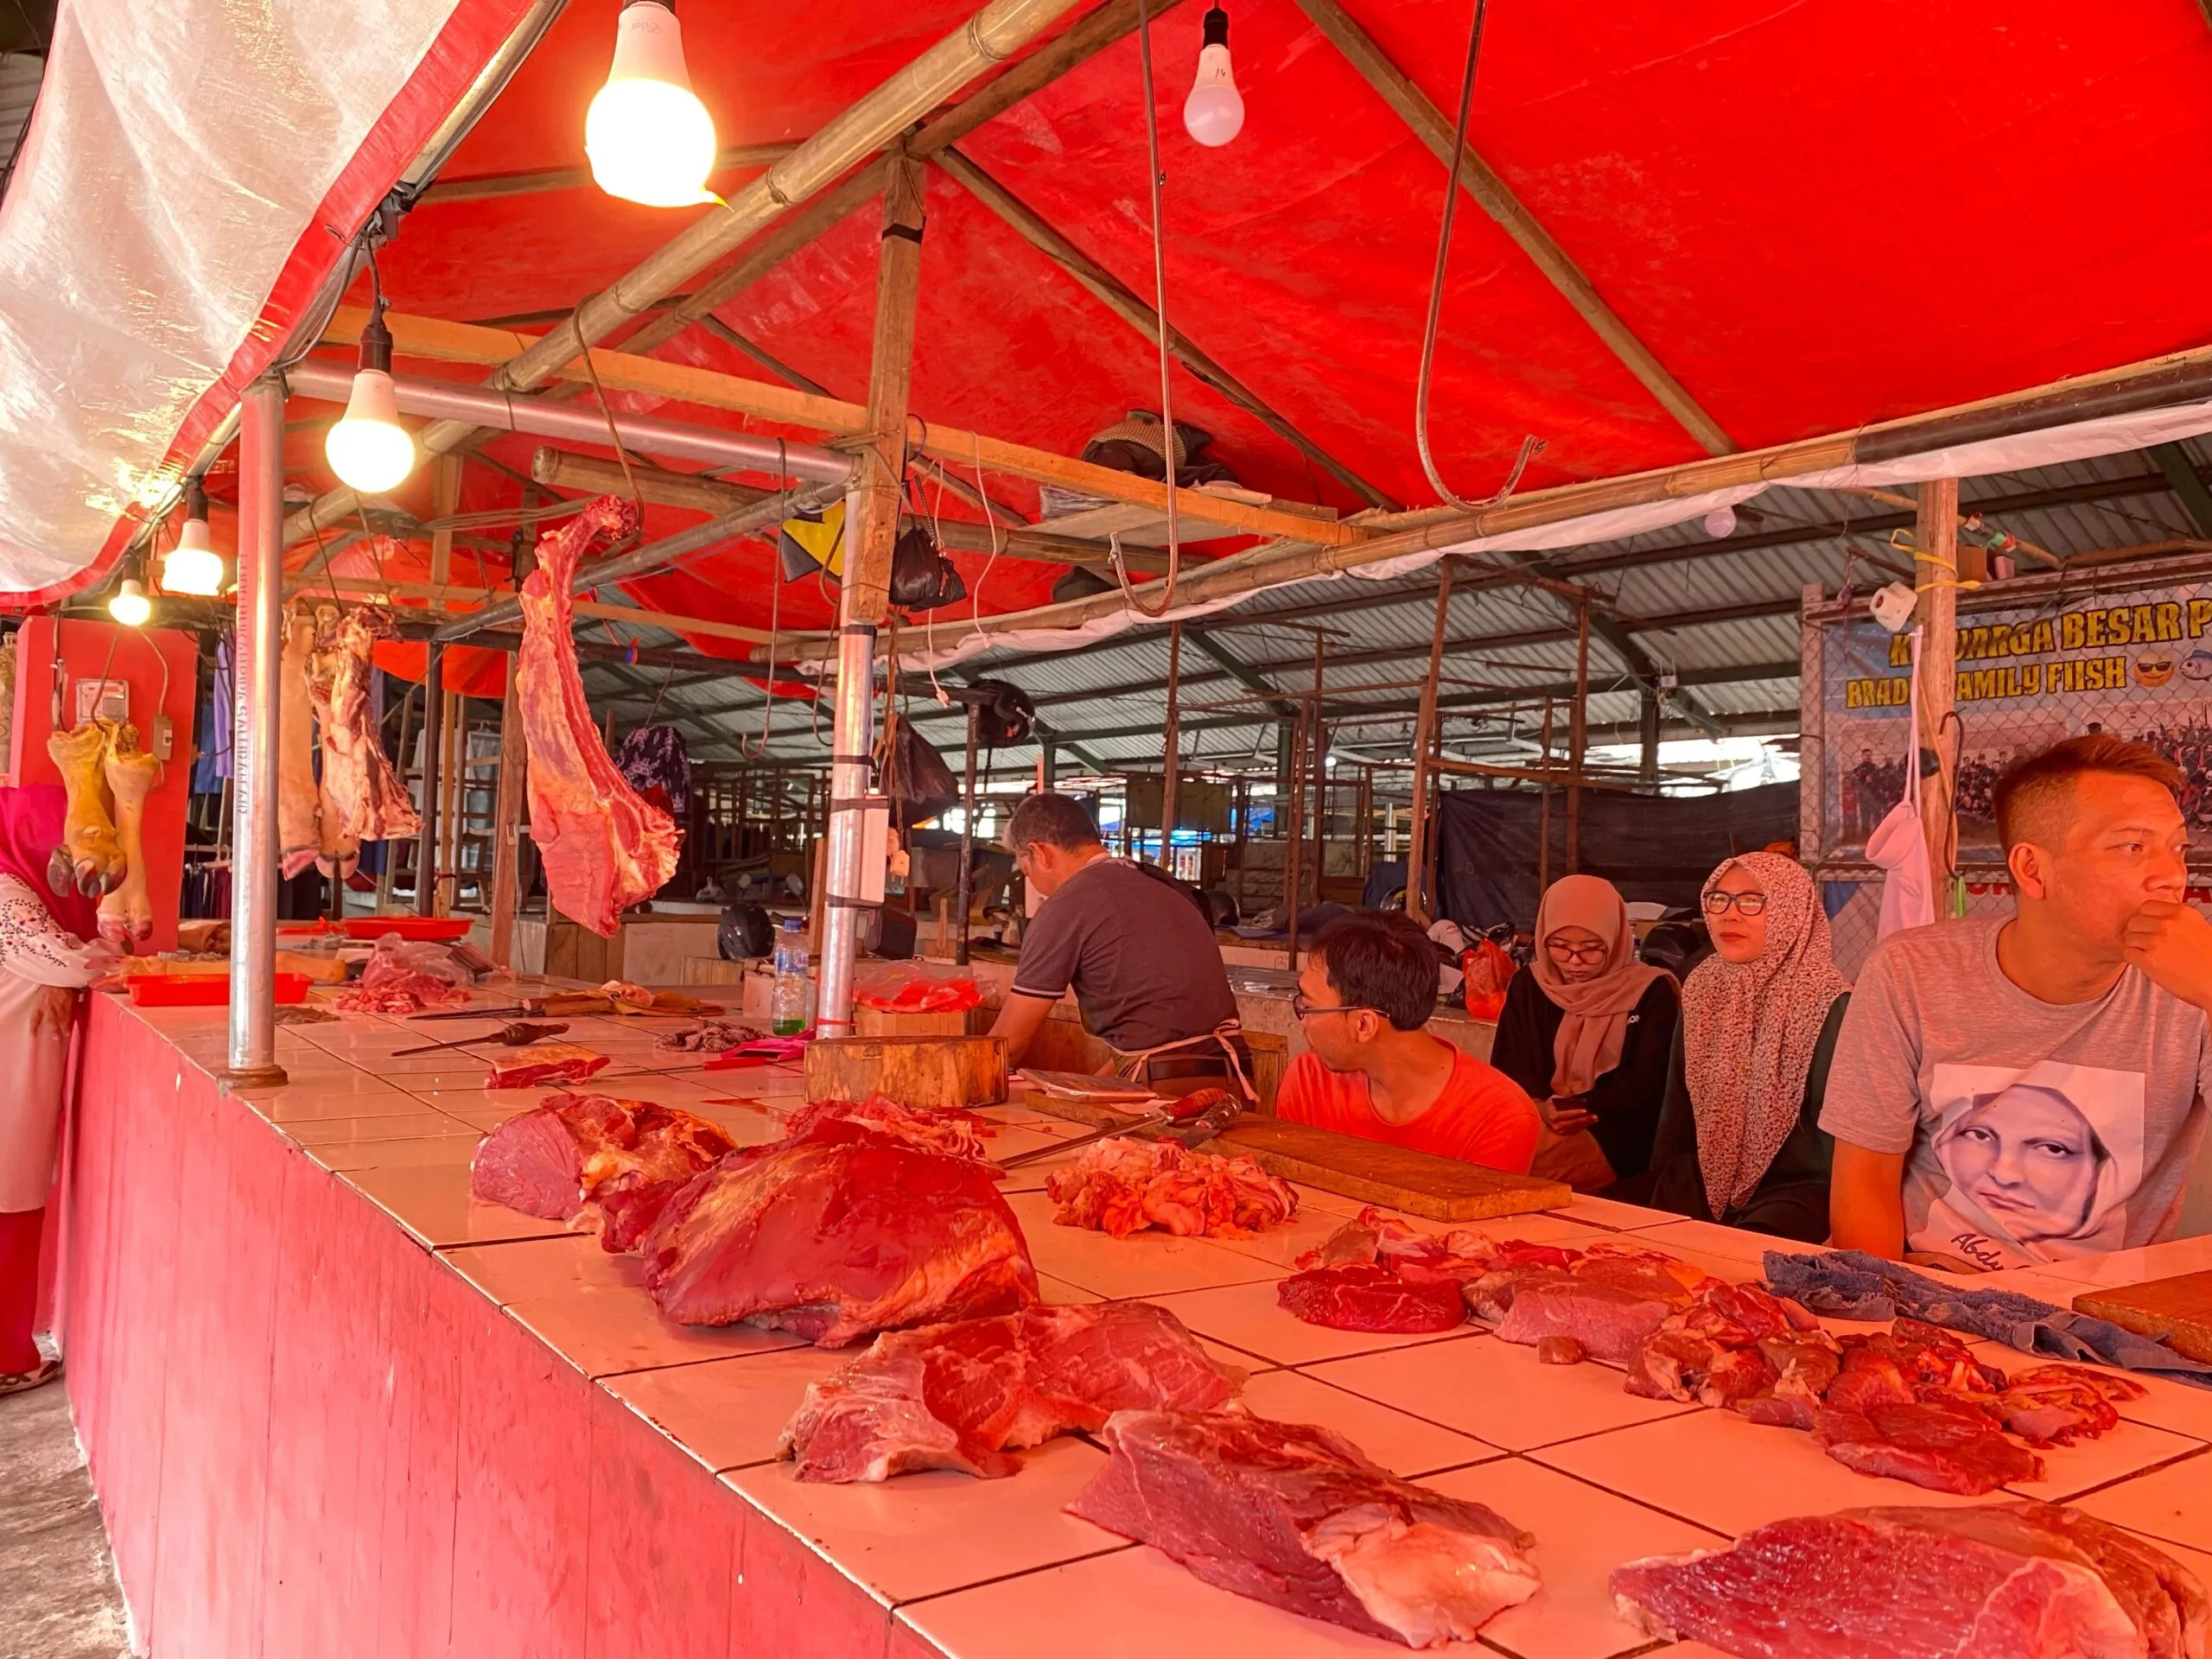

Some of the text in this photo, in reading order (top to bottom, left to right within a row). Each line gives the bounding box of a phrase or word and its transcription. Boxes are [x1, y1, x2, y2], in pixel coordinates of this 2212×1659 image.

[2061, 601, 2183, 651] BESAR
[1955, 664, 2042, 702] AMILY
[2045, 656, 2127, 694] FIISH
